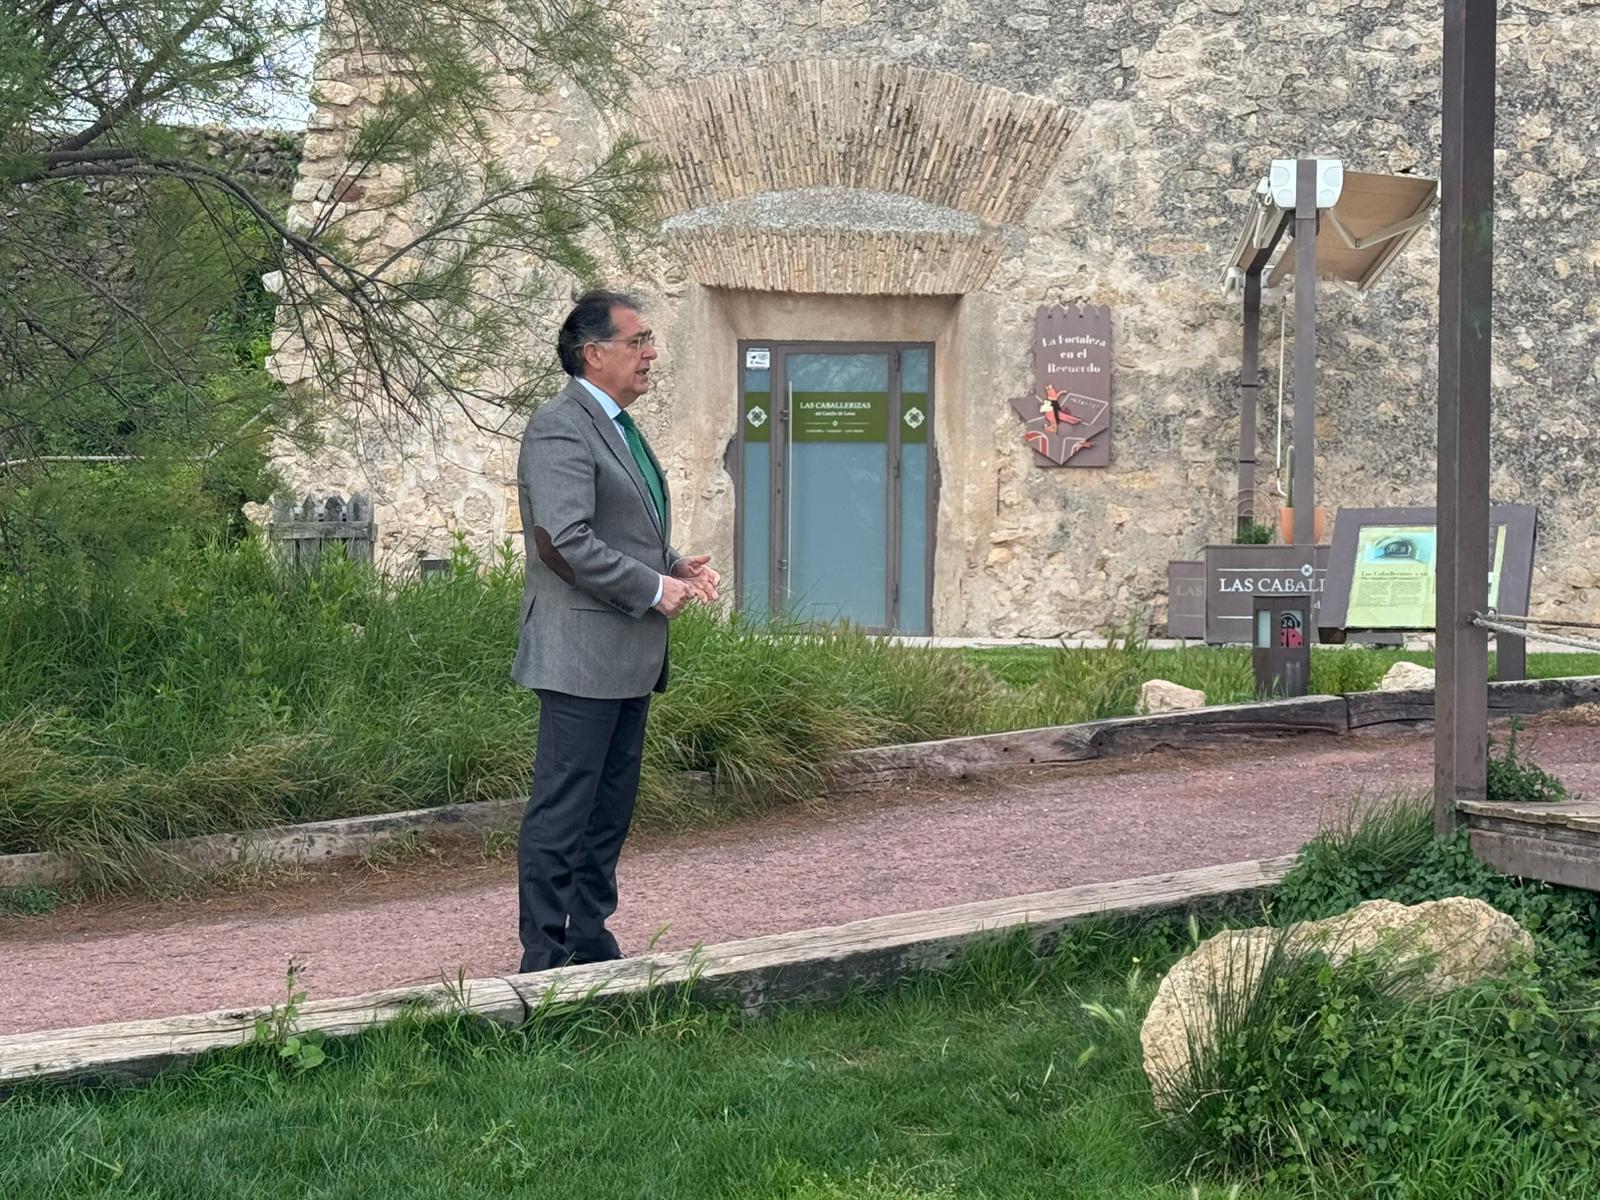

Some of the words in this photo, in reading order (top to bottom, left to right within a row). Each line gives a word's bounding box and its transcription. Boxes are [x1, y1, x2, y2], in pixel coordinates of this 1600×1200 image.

[1042, 338, 1056, 347] La
[1058, 334, 1106, 347] Fortaleza
[1077, 348, 1087, 359] el
[1047, 363, 1101, 373] Recuerdo
[800, 401, 814, 409] LAS
[815, 401, 871, 409] CABALLERIZAS
[1218, 577, 1254, 593] LAS
[1176, 585, 1203, 597] LAS
